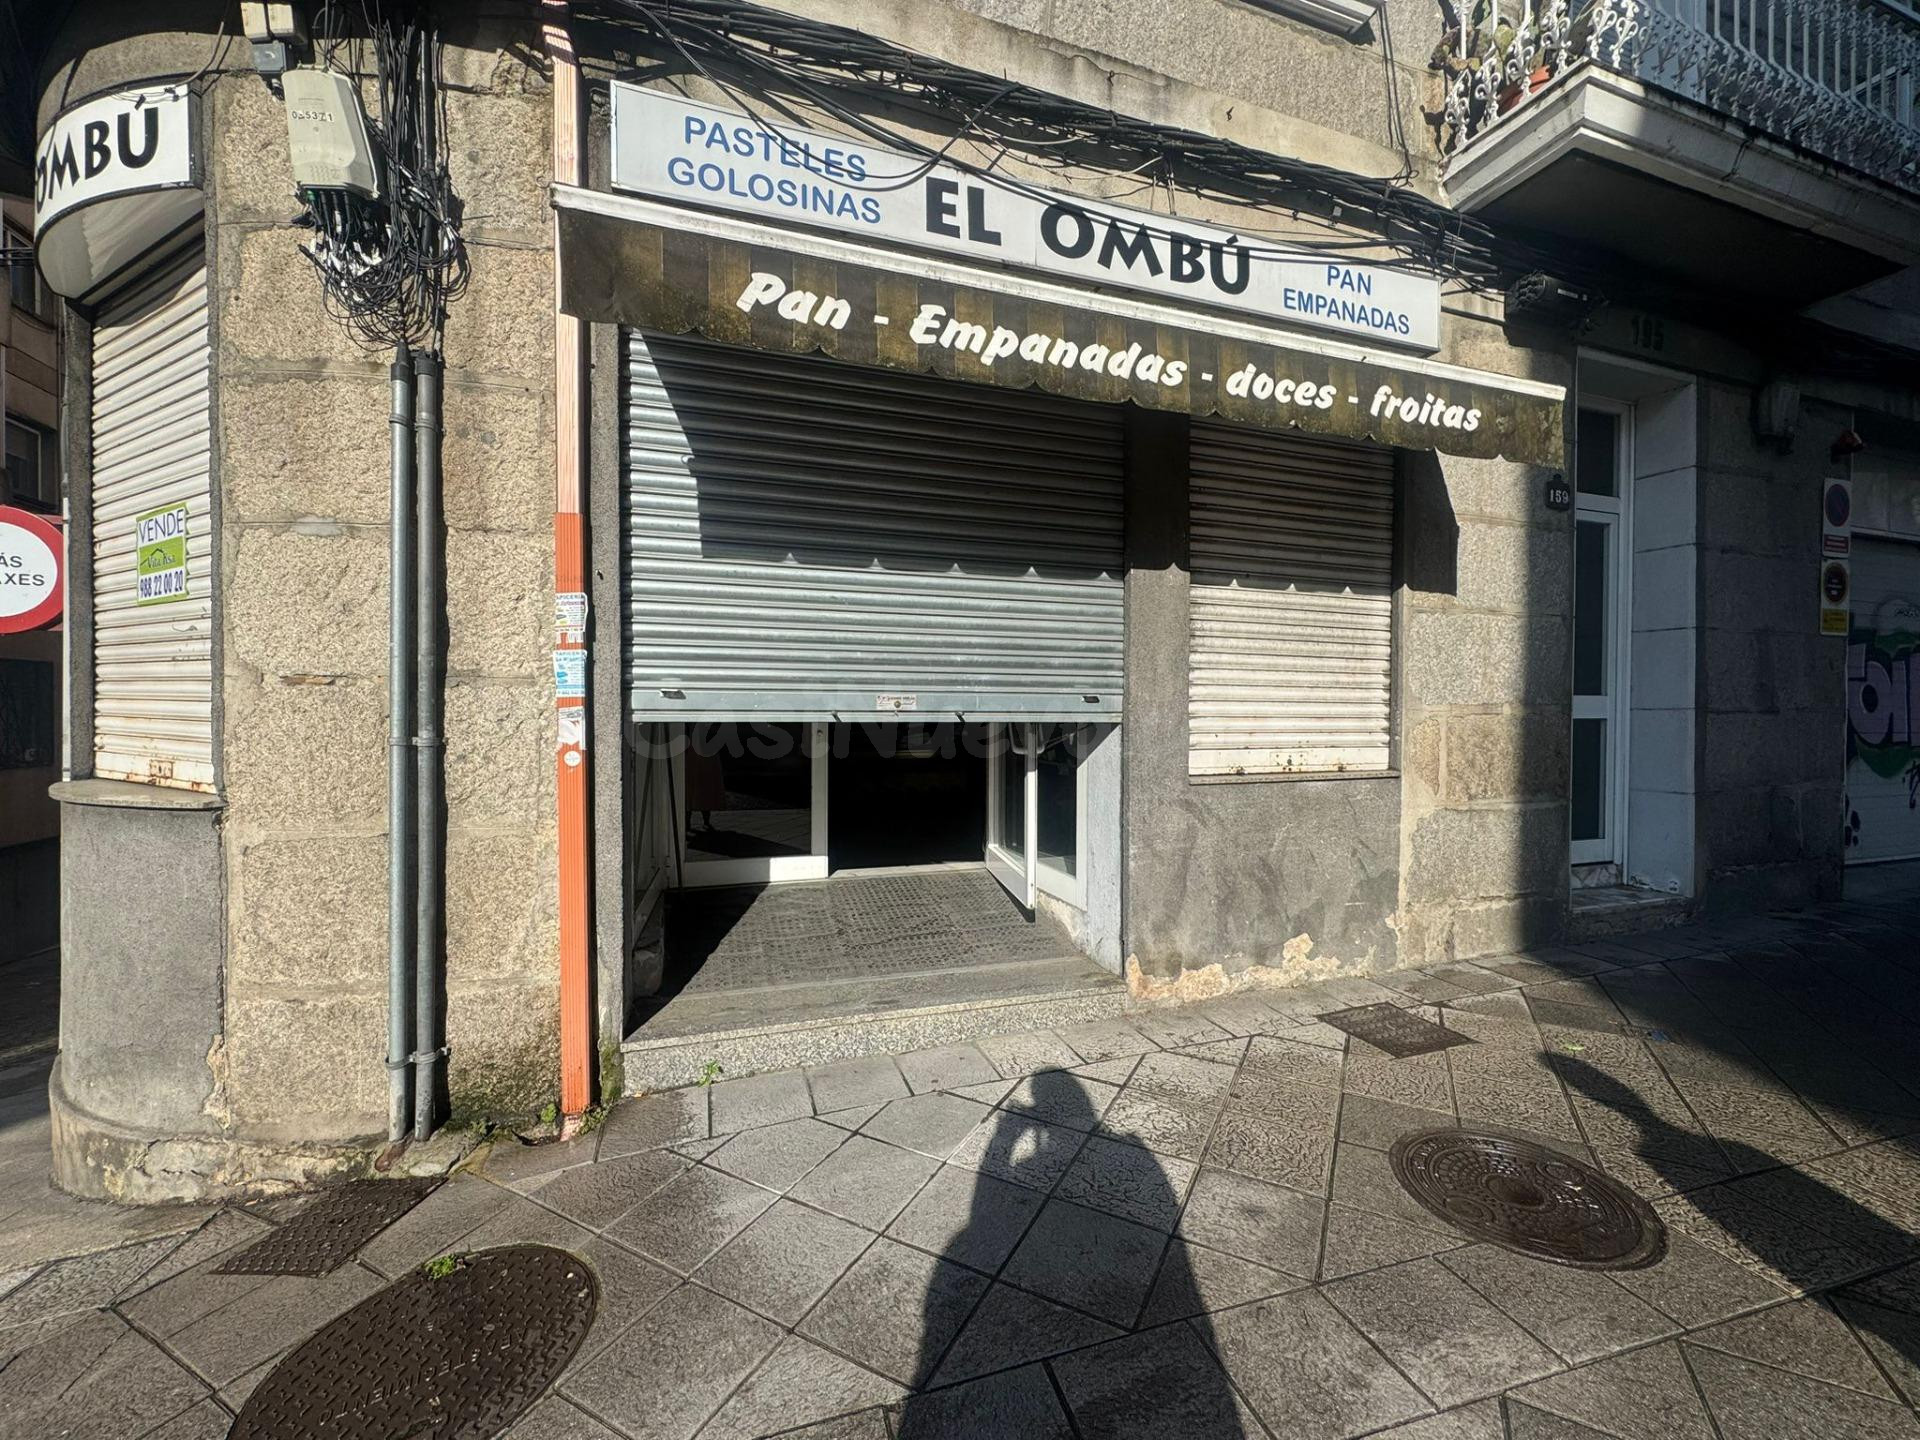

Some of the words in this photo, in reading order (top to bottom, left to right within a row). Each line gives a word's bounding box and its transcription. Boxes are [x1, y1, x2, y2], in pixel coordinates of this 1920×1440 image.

[685, 116, 866, 182] PASTELES
[667, 157, 881, 224] GOLOSINAS
[926, 176, 1002, 246] EL
[1040, 202, 1251, 295] OMBÚ
[1327, 264, 1372, 296] PAN
[1283, 288, 1410, 335] EMPANADAS
[736, 271, 851, 330] Pan
[909, 303, 1188, 387] Empanadas
[1225, 362, 1337, 410] doces
[1369, 384, 1483, 432] froitas
[138, 508, 184, 544] VENDE
[0, 572, 46, 587] XES
[140, 576, 152, 599] 988
[153, 573, 163, 597] 22
[164, 571, 173, 595] 00
[174, 569, 184, 593] 20
